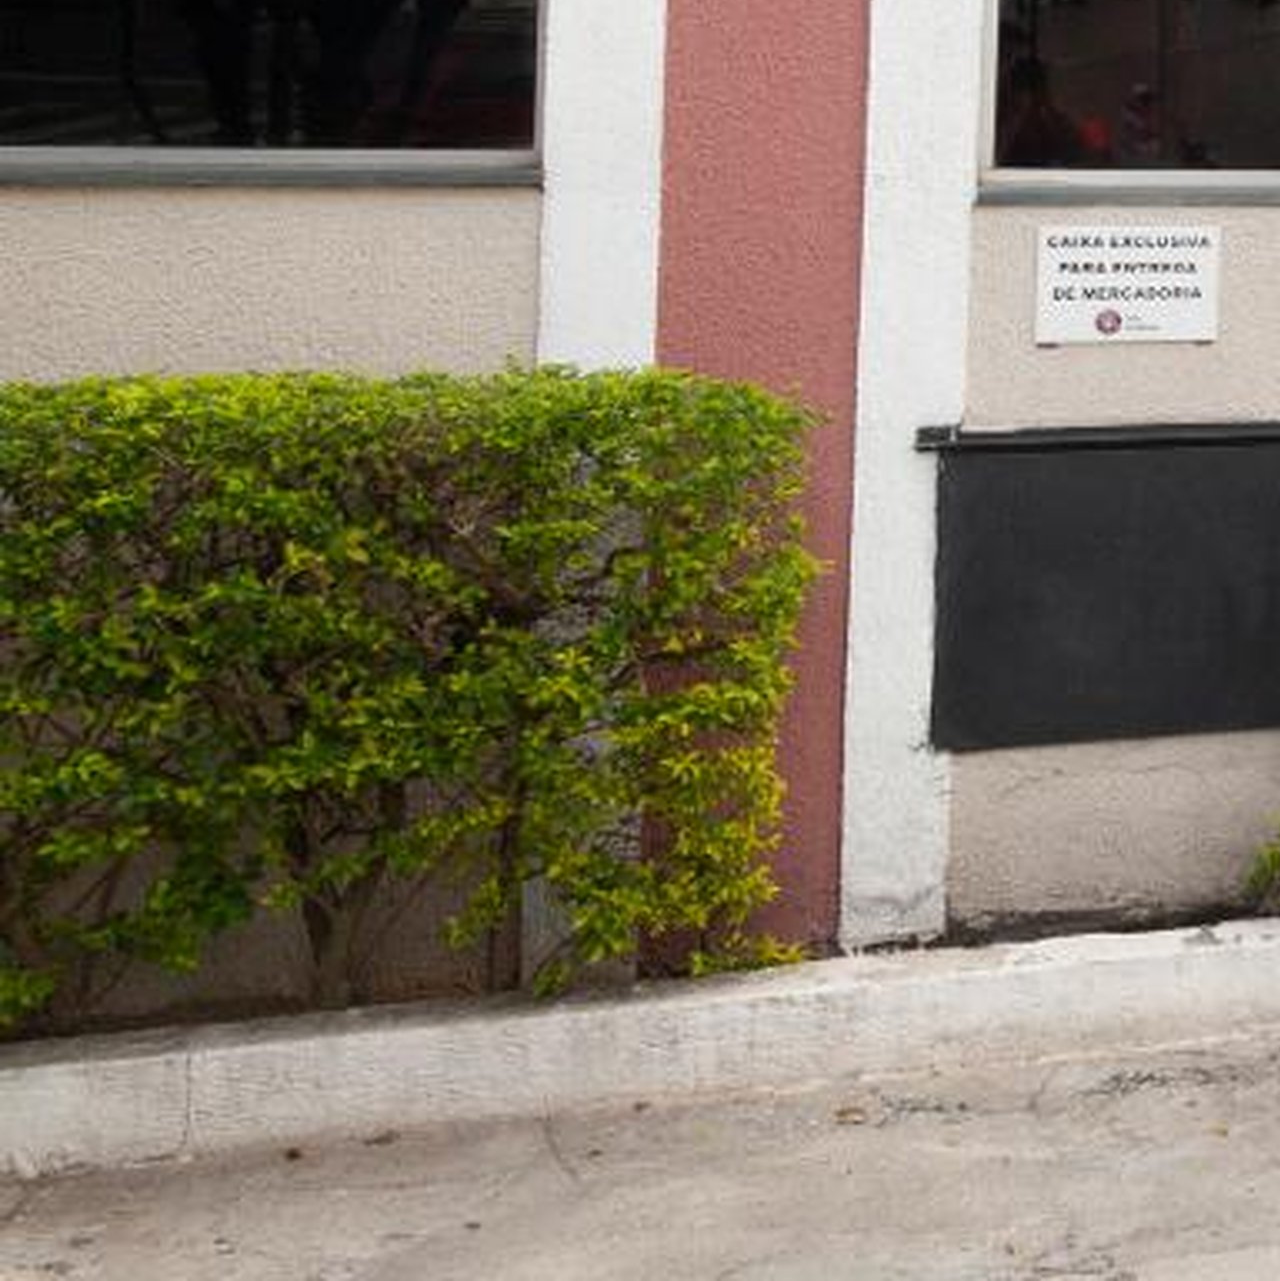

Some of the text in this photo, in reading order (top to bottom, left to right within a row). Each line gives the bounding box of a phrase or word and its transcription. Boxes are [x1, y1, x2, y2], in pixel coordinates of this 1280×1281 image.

[1046, 235, 1211, 249] CAIXA EXCLUSIVA
[1058, 262, 1107, 274] PARA
[1052, 286, 1203, 302] DE MERCADORIA
